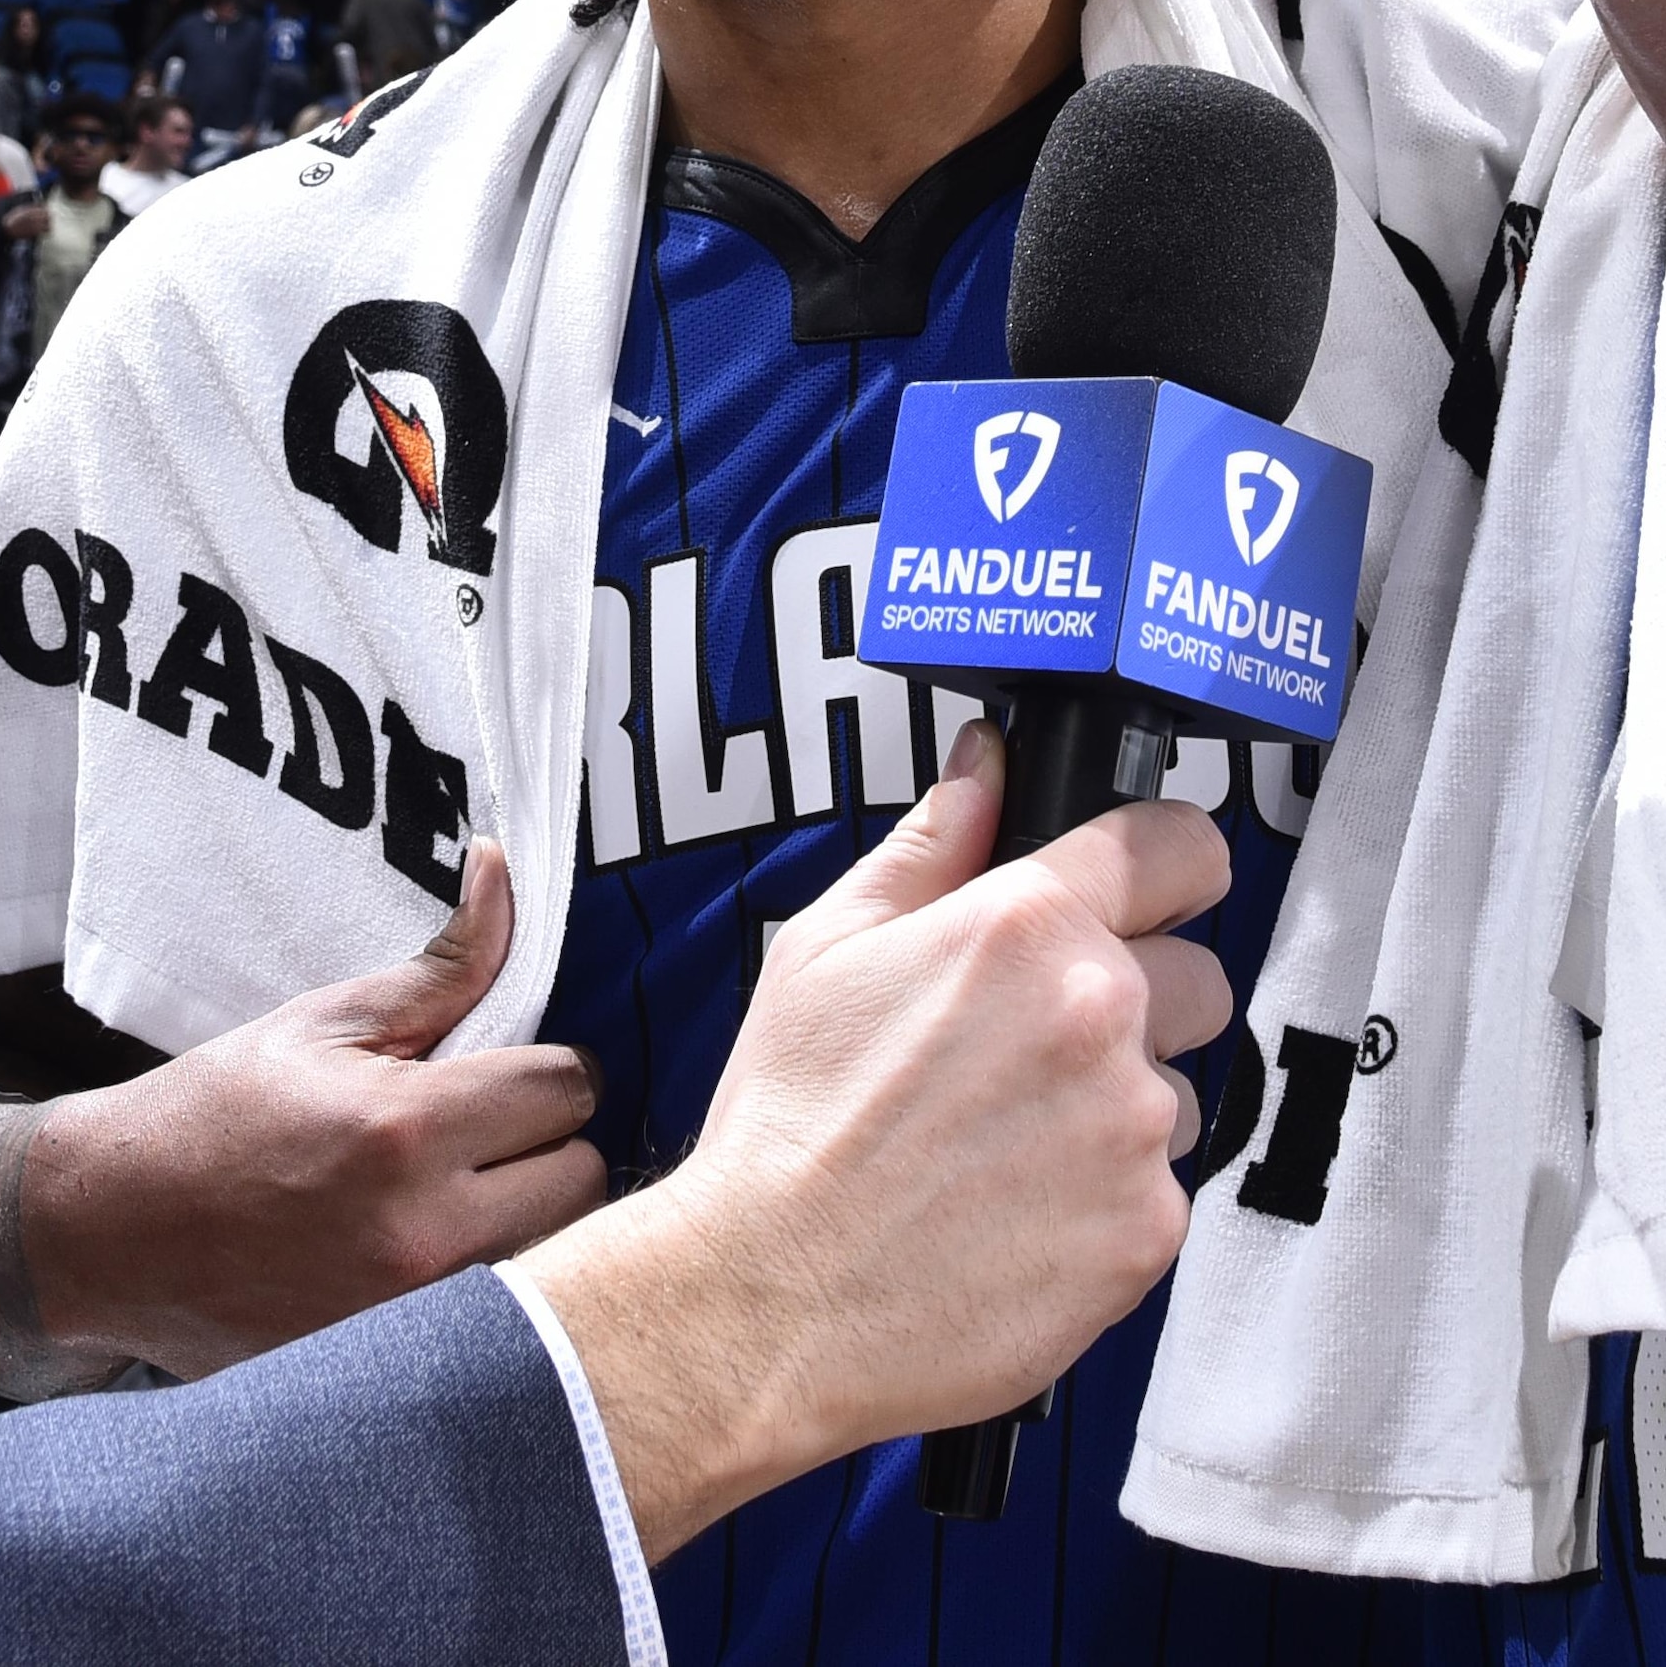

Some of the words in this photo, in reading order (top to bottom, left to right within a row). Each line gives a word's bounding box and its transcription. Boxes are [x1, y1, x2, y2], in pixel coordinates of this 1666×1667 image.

[887, 547, 1103, 598] FANDUEL
[881, 604, 972, 633] SPORTS
[975, 608, 1097, 638] NETWORK
[1145, 560, 1331, 668] FANDUEL
[1139, 622, 1224, 672] SPORTS
[1226, 650, 1327, 707] NETWORK
